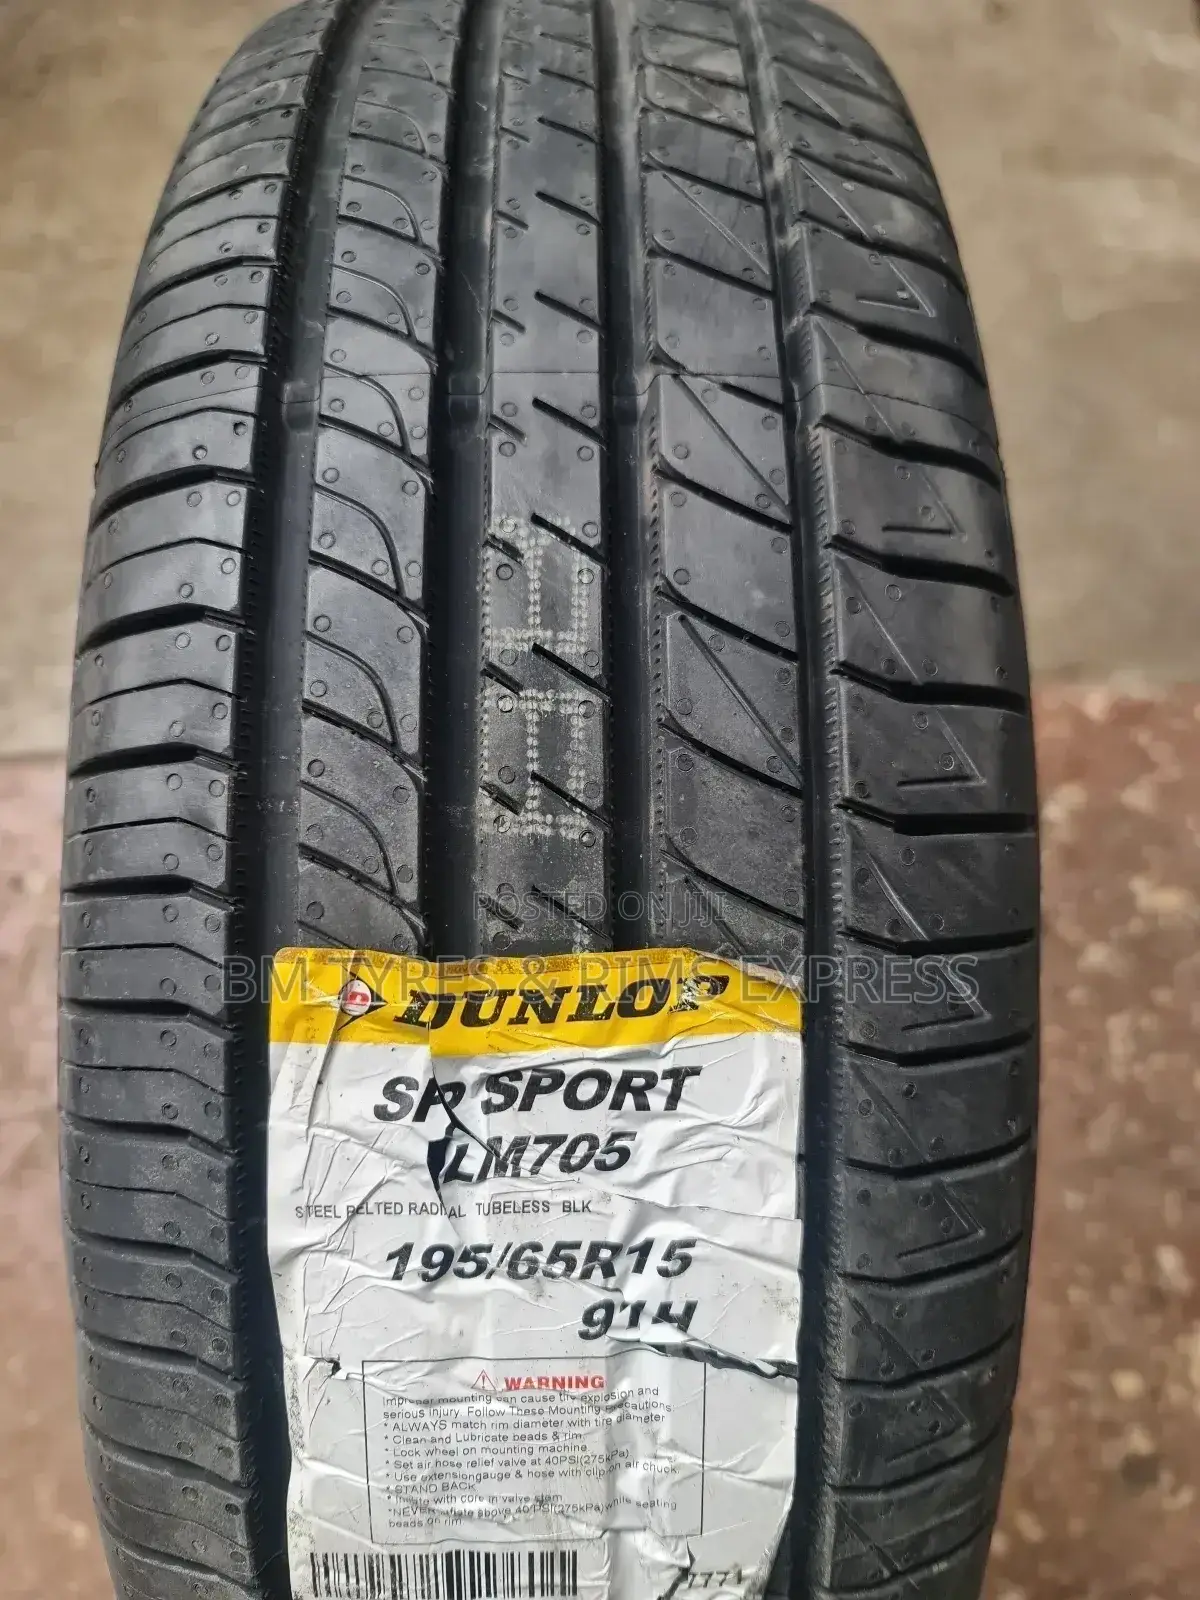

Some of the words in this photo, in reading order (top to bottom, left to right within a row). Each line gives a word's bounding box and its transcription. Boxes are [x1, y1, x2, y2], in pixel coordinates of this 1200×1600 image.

[393, 976, 731, 1030] DUNLOP
[373, 1076, 467, 1122] SP
[480, 1065, 703, 1115] SPORT
[443, 1130, 638, 1184] LM705
[295, 1205, 342, 1219] STEEL
[408, 1202, 467, 1218] RADIAL
[476, 1200, 550, 1216] TUBELESS
[562, 1200, 592, 1213] BLK
[386, 1237, 698, 1282] 195/65R15
[577, 1298, 699, 1341] 91H
[504, 1375, 605, 1391] WARNING
[438, 1393, 492, 1405] mounting
[520, 1394, 555, 1404] cause
[580, 1389, 634, 1404] explosion
[637, 1386, 659, 1397] and
[383, 1408, 425, 1419] serious
[467, 1406, 506, 1417] Follow
[509, 1406, 545, 1416] These
[548, 1404, 600, 1415] Mounting
[392, 1420, 447, 1432] ALWAYS
[451, 1420, 487, 1430] match
[491, 1419, 509, 1430] rim
[513, 1417, 564, 1429] diameter
[567, 1416, 591, 1427] with
[595, 1416, 612, 1427] tire
[616, 1411, 665, 1424] diameter
[392, 1435, 427, 1445] Clean
[430, 1435, 451, 1444] and
[455, 1433, 509, 1444] Lubricate
[513, 1431, 548, 1442] beads
[551, 1431, 560, 1441] &
[393, 1447, 421, 1457] Lock
[424, 1446, 459, 1457] wheel
[462, 1447, 477, 1456] on
[480, 1445, 534, 1456] mounting
[393, 1460, 413, 1469] Set
[417, 1460, 431, 1469] air
[435, 1458, 462, 1468] hose
[466, 1457, 495, 1469] relief
[498, 1457, 527, 1467] valve
[530, 1457, 542, 1466] at
[394, 1472, 417, 1482] Use
[514, 1470, 523, 1478] &
[527, 1469, 555, 1478] hose
[558, 1467, 582, 1477] with
[625, 1460, 640, 1469] air
[395, 1484, 438, 1494] STAND
[433, 1494, 457, 1504] with
[460, 1494, 484, 1503] core
[502, 1493, 530, 1503] valve
[477, 1507, 511, 1518] above
[636, 1498, 678, 1511] seating
[388, 1520, 424, 1528] beads
[427, 1517, 441, 1525] on
